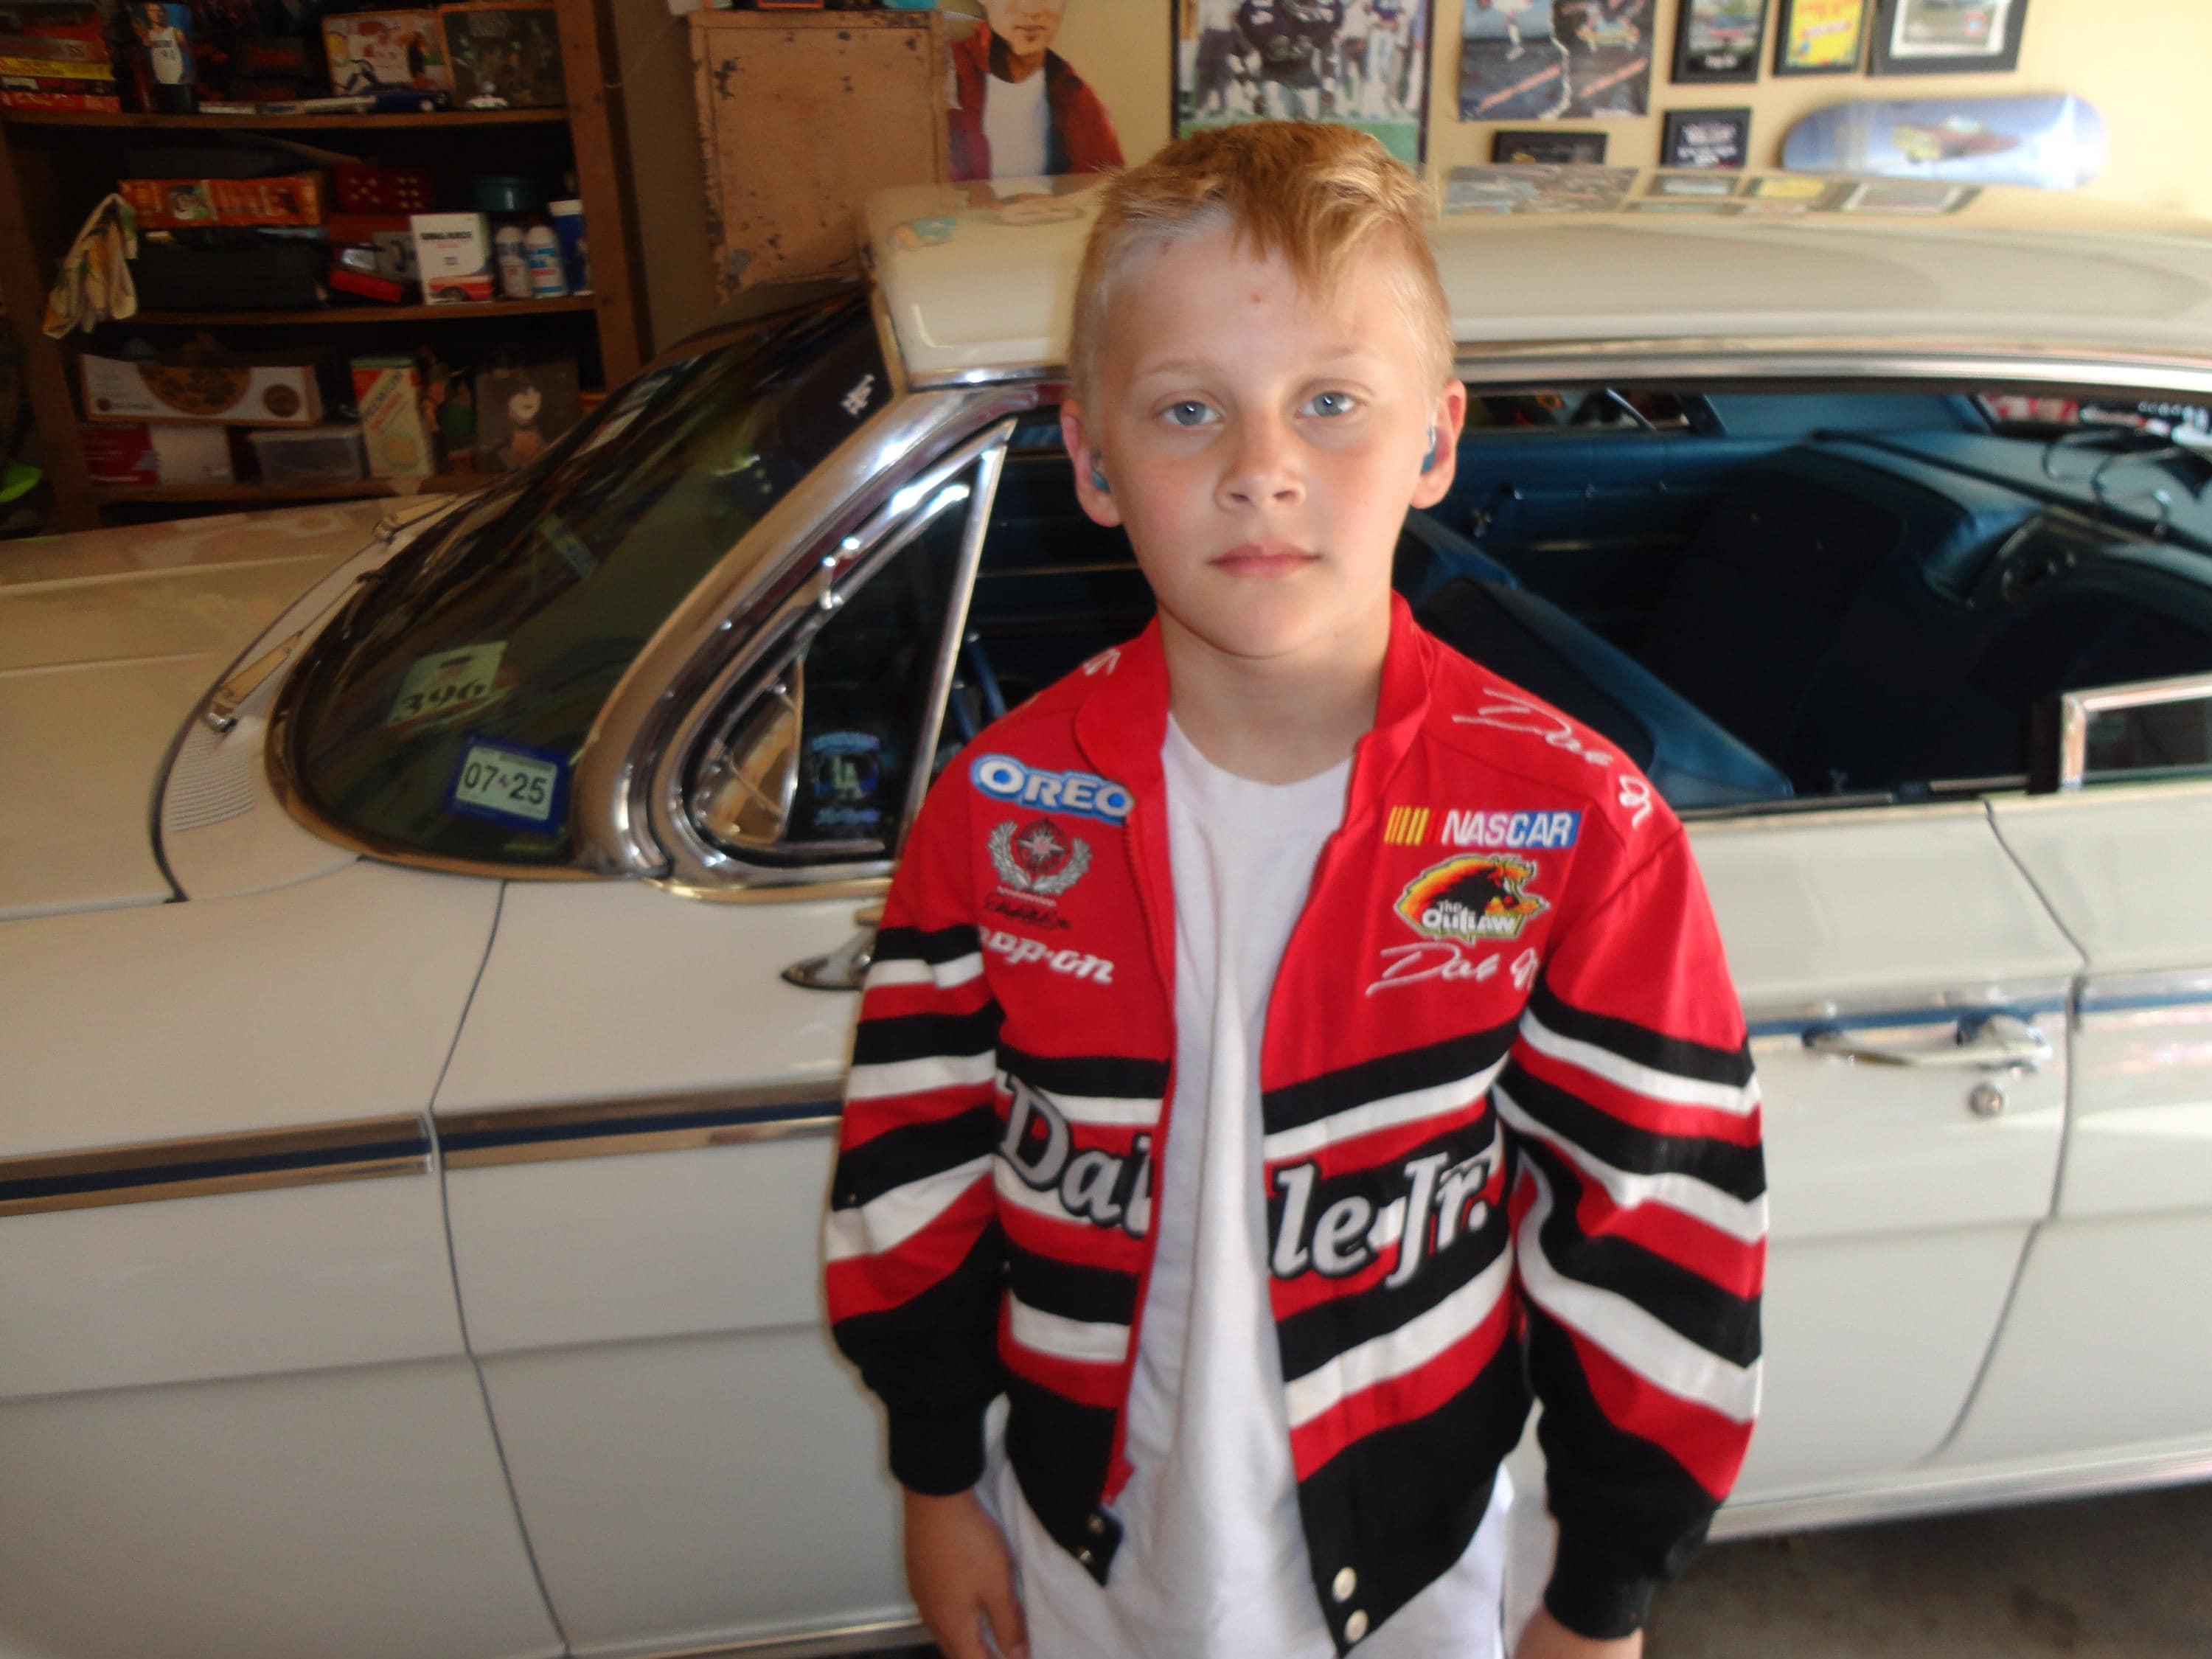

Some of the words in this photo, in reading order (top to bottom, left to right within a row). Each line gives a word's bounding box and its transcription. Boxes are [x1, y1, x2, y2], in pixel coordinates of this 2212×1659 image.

[464, 762, 499, 793] 07
[509, 772, 548, 805] 25
[975, 757, 1135, 819] OREO
[1441, 809, 1573, 847] NASCAR
